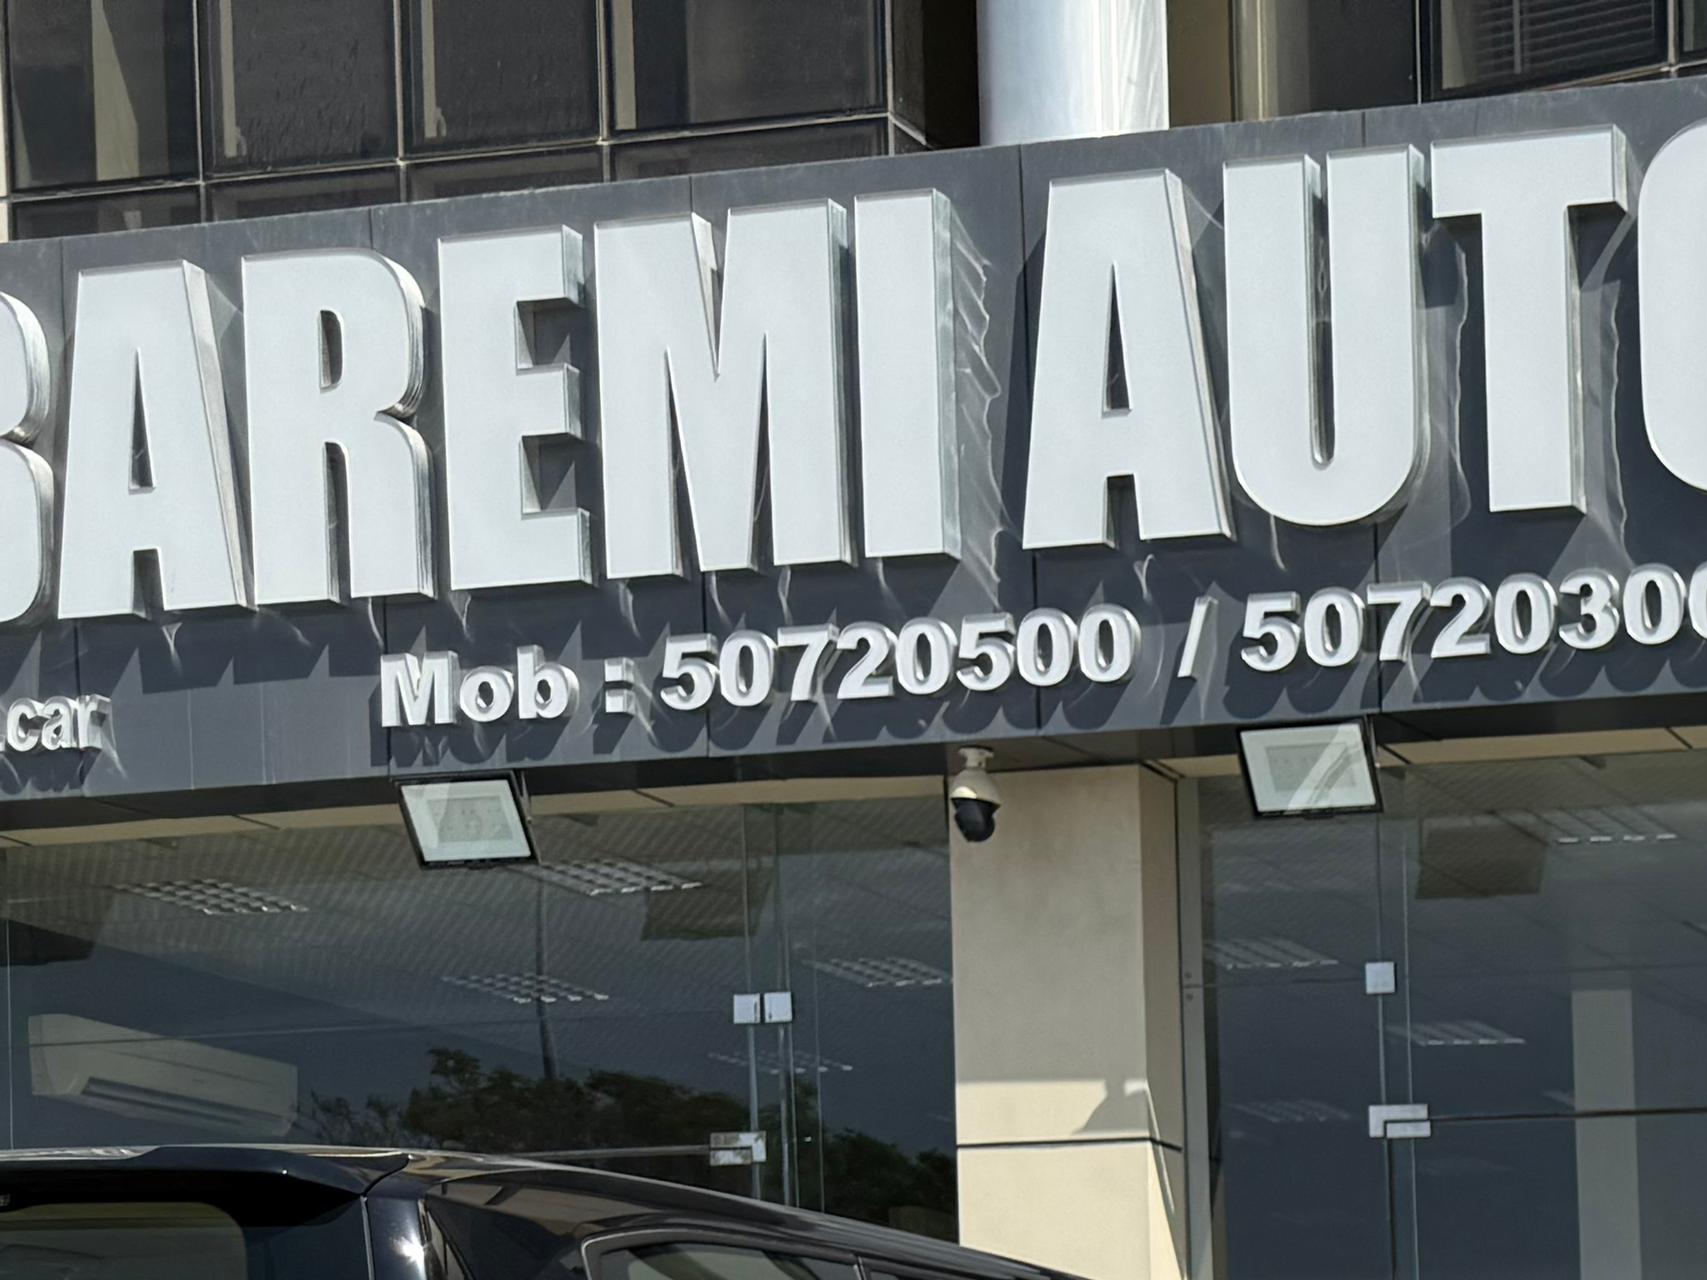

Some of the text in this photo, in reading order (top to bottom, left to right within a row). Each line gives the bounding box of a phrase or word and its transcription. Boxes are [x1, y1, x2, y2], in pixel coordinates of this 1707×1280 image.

[0, 186, 962, 622] AREMI
[380, 652, 571, 728] Mob
[660, 607, 1138, 712] 50720500
